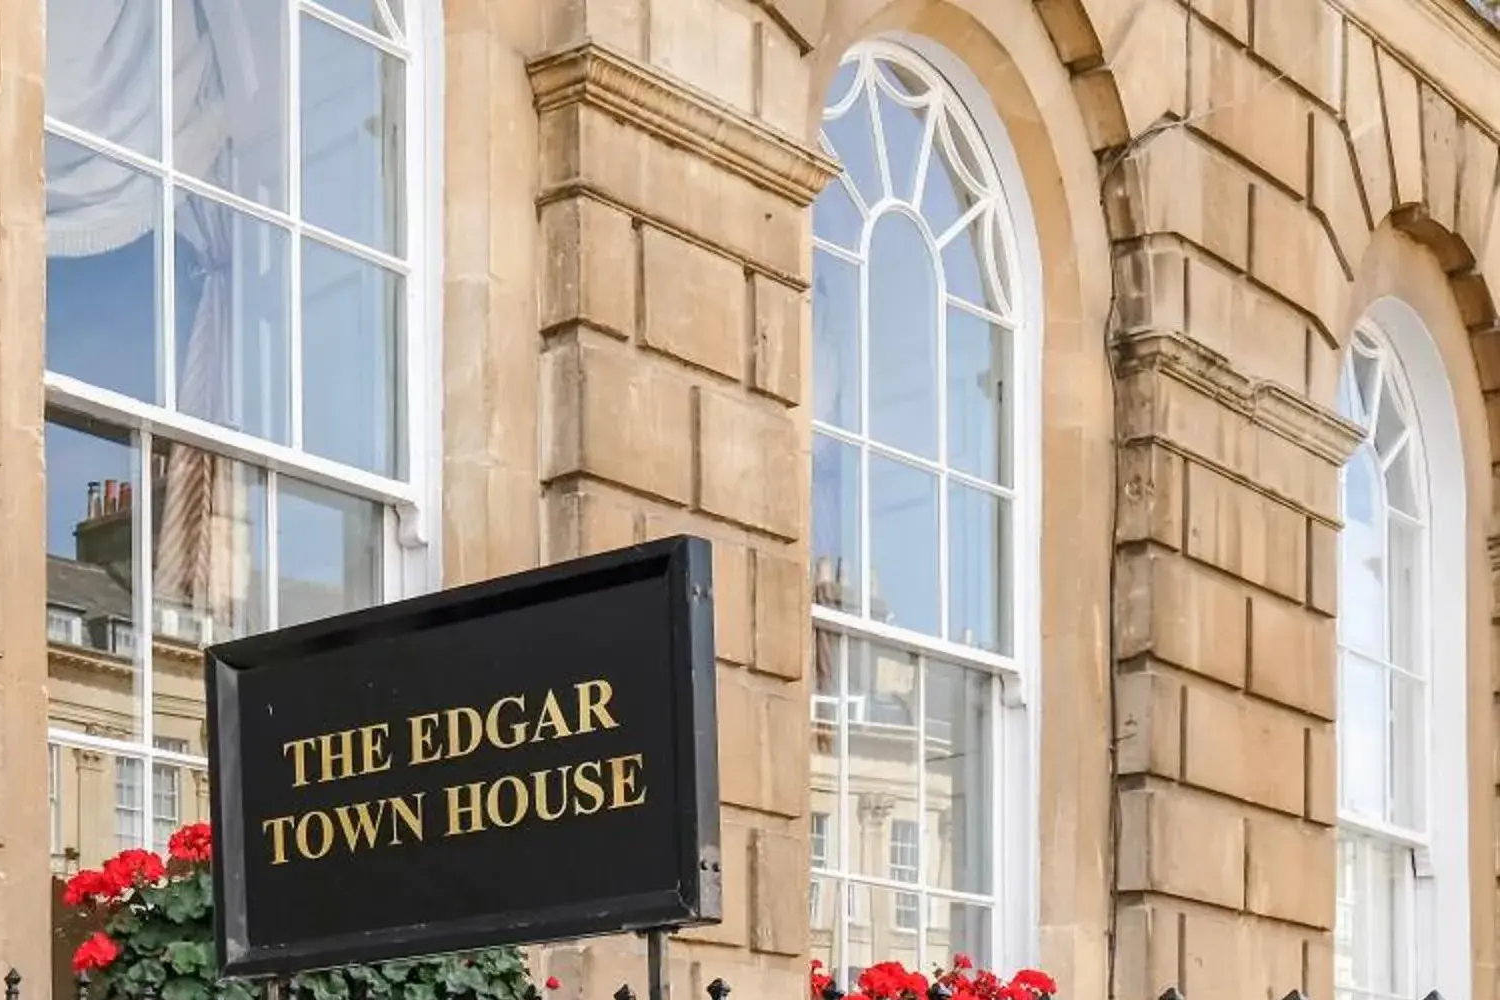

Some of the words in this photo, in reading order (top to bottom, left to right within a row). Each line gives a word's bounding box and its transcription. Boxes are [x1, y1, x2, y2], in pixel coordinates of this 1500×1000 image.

[283, 722, 392, 788] THE
[407, 679, 620, 766] EDGAR
[262, 792, 426, 865] TOWN
[443, 753, 647, 837] HOUSE
